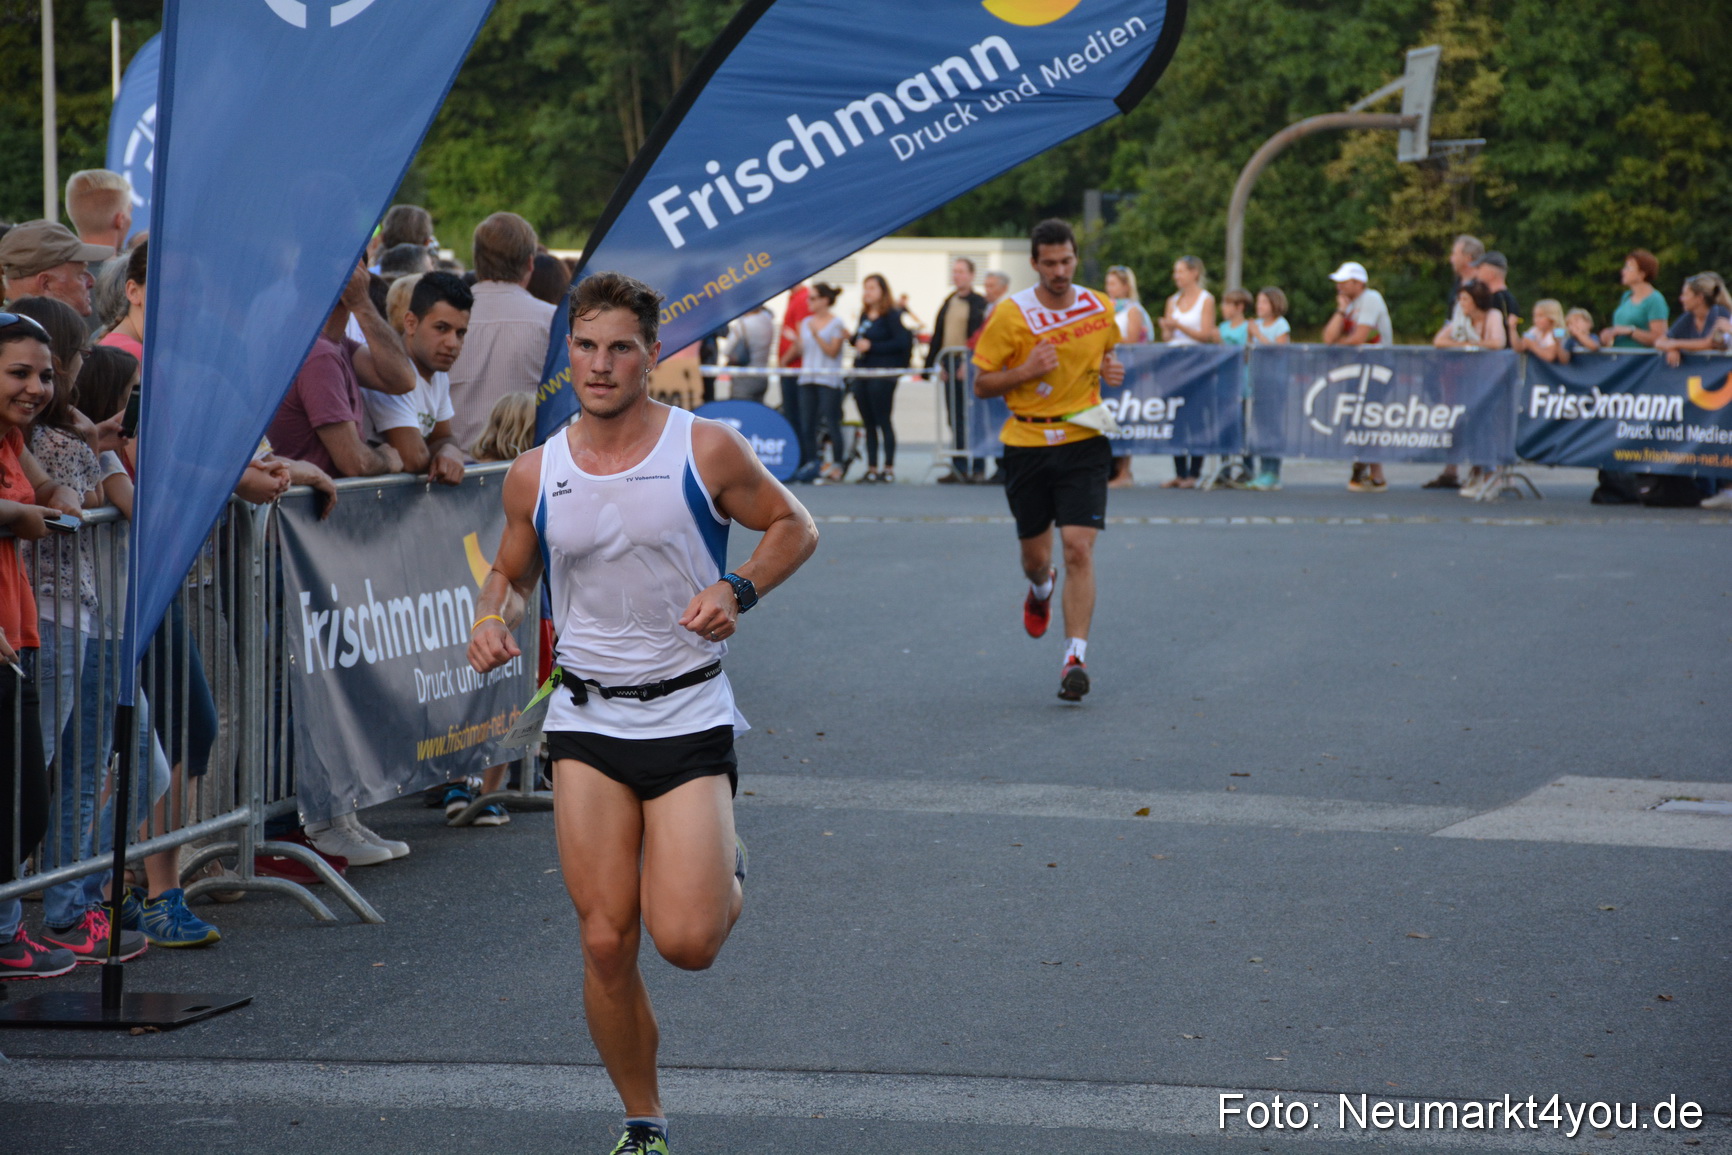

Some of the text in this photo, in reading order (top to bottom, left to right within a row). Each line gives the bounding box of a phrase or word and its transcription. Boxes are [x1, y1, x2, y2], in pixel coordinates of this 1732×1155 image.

[889, 16, 1147, 161] Druck und Medien
[648, 35, 1020, 249] Frischmann
[1332, 393, 1466, 429] Fischer
[1529, 384, 1684, 421] Frischmann
[1344, 430, 1453, 448] AUTOMOBILE
[1616, 420, 1652, 440] Druck
[1656, 423, 1684, 441] und
[552, 488, 572, 497] erima
[300, 578, 476, 674] Frischmann
[414, 660, 455, 704] Druck
